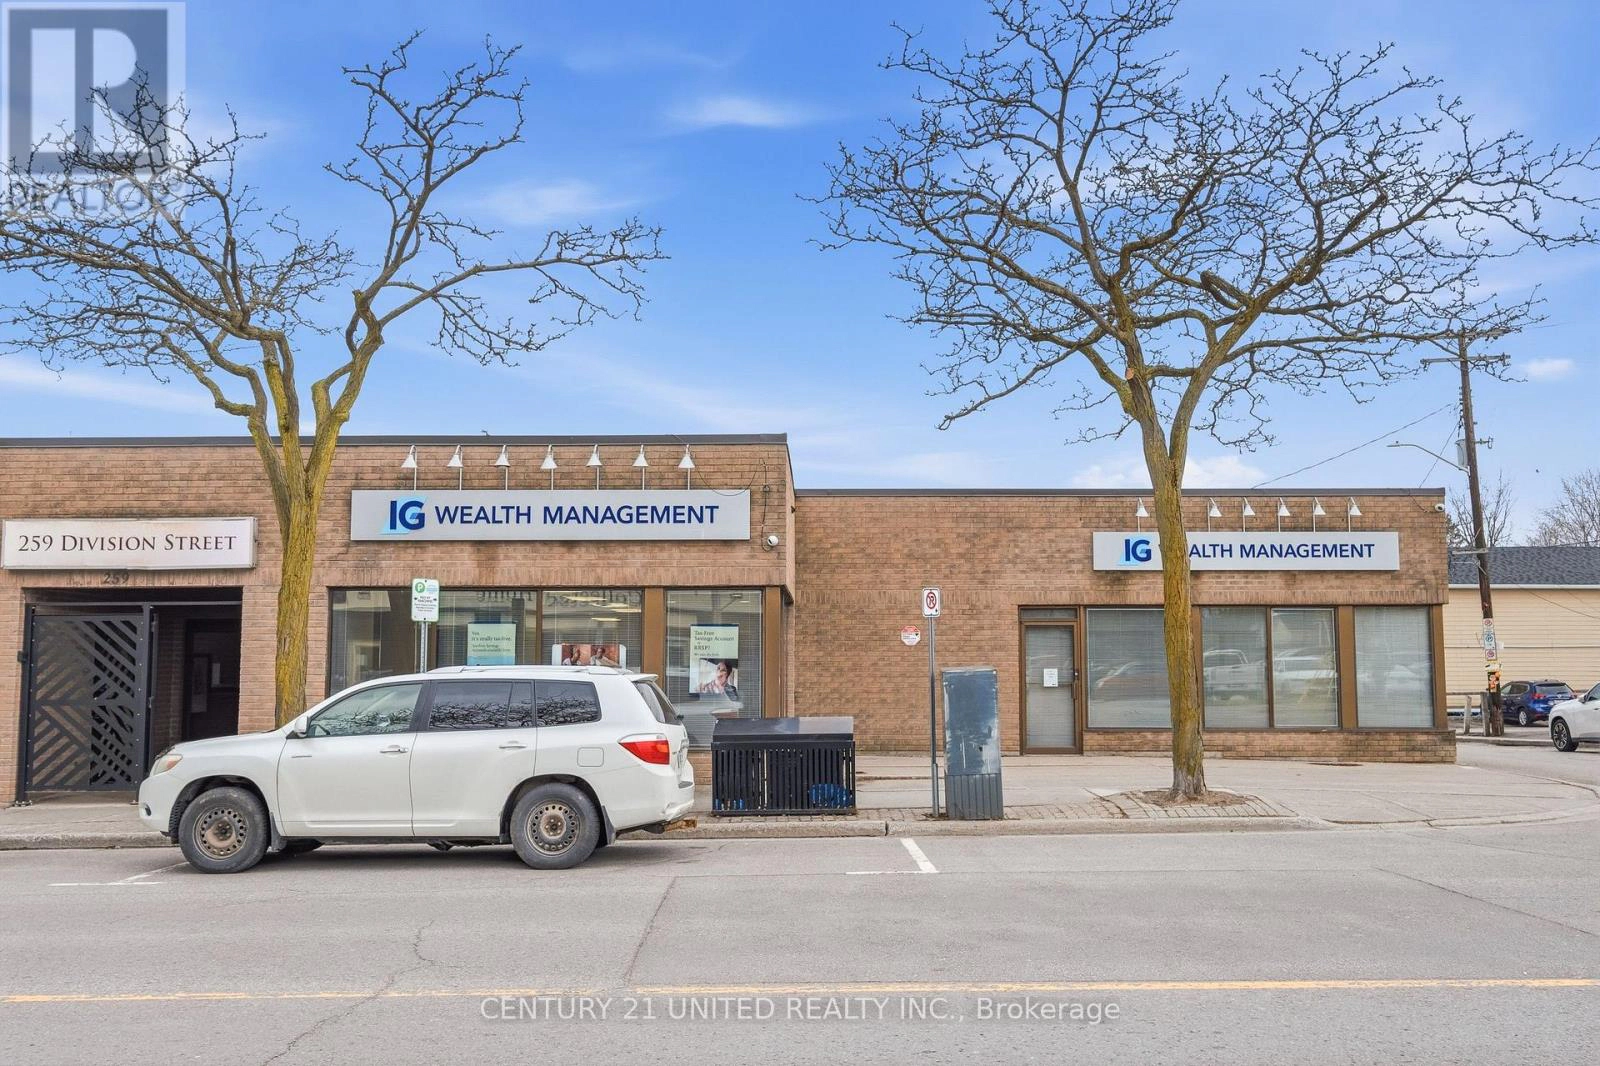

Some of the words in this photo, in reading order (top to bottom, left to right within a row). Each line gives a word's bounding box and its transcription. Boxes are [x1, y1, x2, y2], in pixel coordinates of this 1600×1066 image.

[390, 501, 425, 530] IG
[435, 506, 531, 524] WEALTH
[543, 506, 719, 524] MANAGEMENT
[19, 534, 53, 552] 259
[1124, 539, 1152, 562] IG
[1188, 543, 1233, 558] ALTH
[1240, 543, 1375, 558] MANAGEMENT
[103, 571, 130, 585] 259
